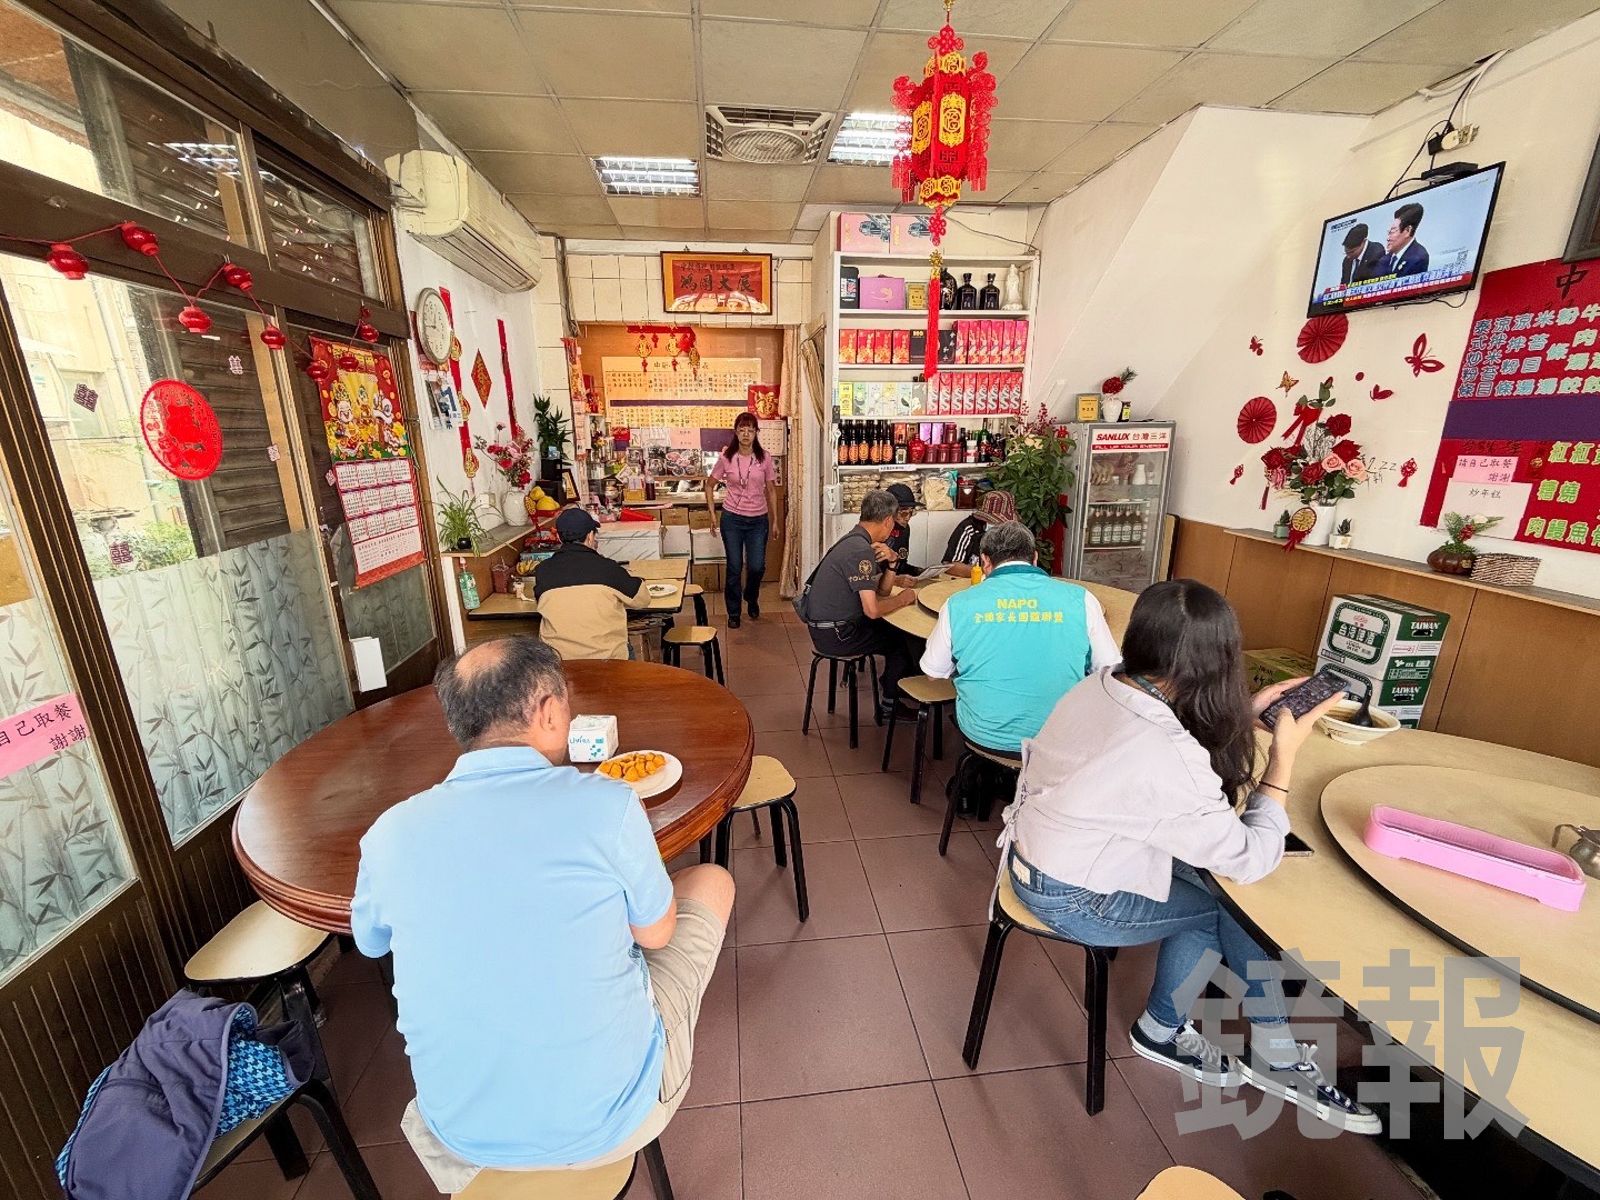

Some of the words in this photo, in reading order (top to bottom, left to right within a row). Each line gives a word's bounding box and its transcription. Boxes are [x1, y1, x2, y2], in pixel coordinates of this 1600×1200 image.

[1096, 432, 1130, 441] SANLUX
[1132, 432, 1167, 440] 台灣三洋
[996, 598, 1039, 610] NAPO
[1411, 621, 1441, 630] TAIWAN
[1392, 686, 1421, 694] TAIWAN
[49, 724, 87, 750] 謝謝
